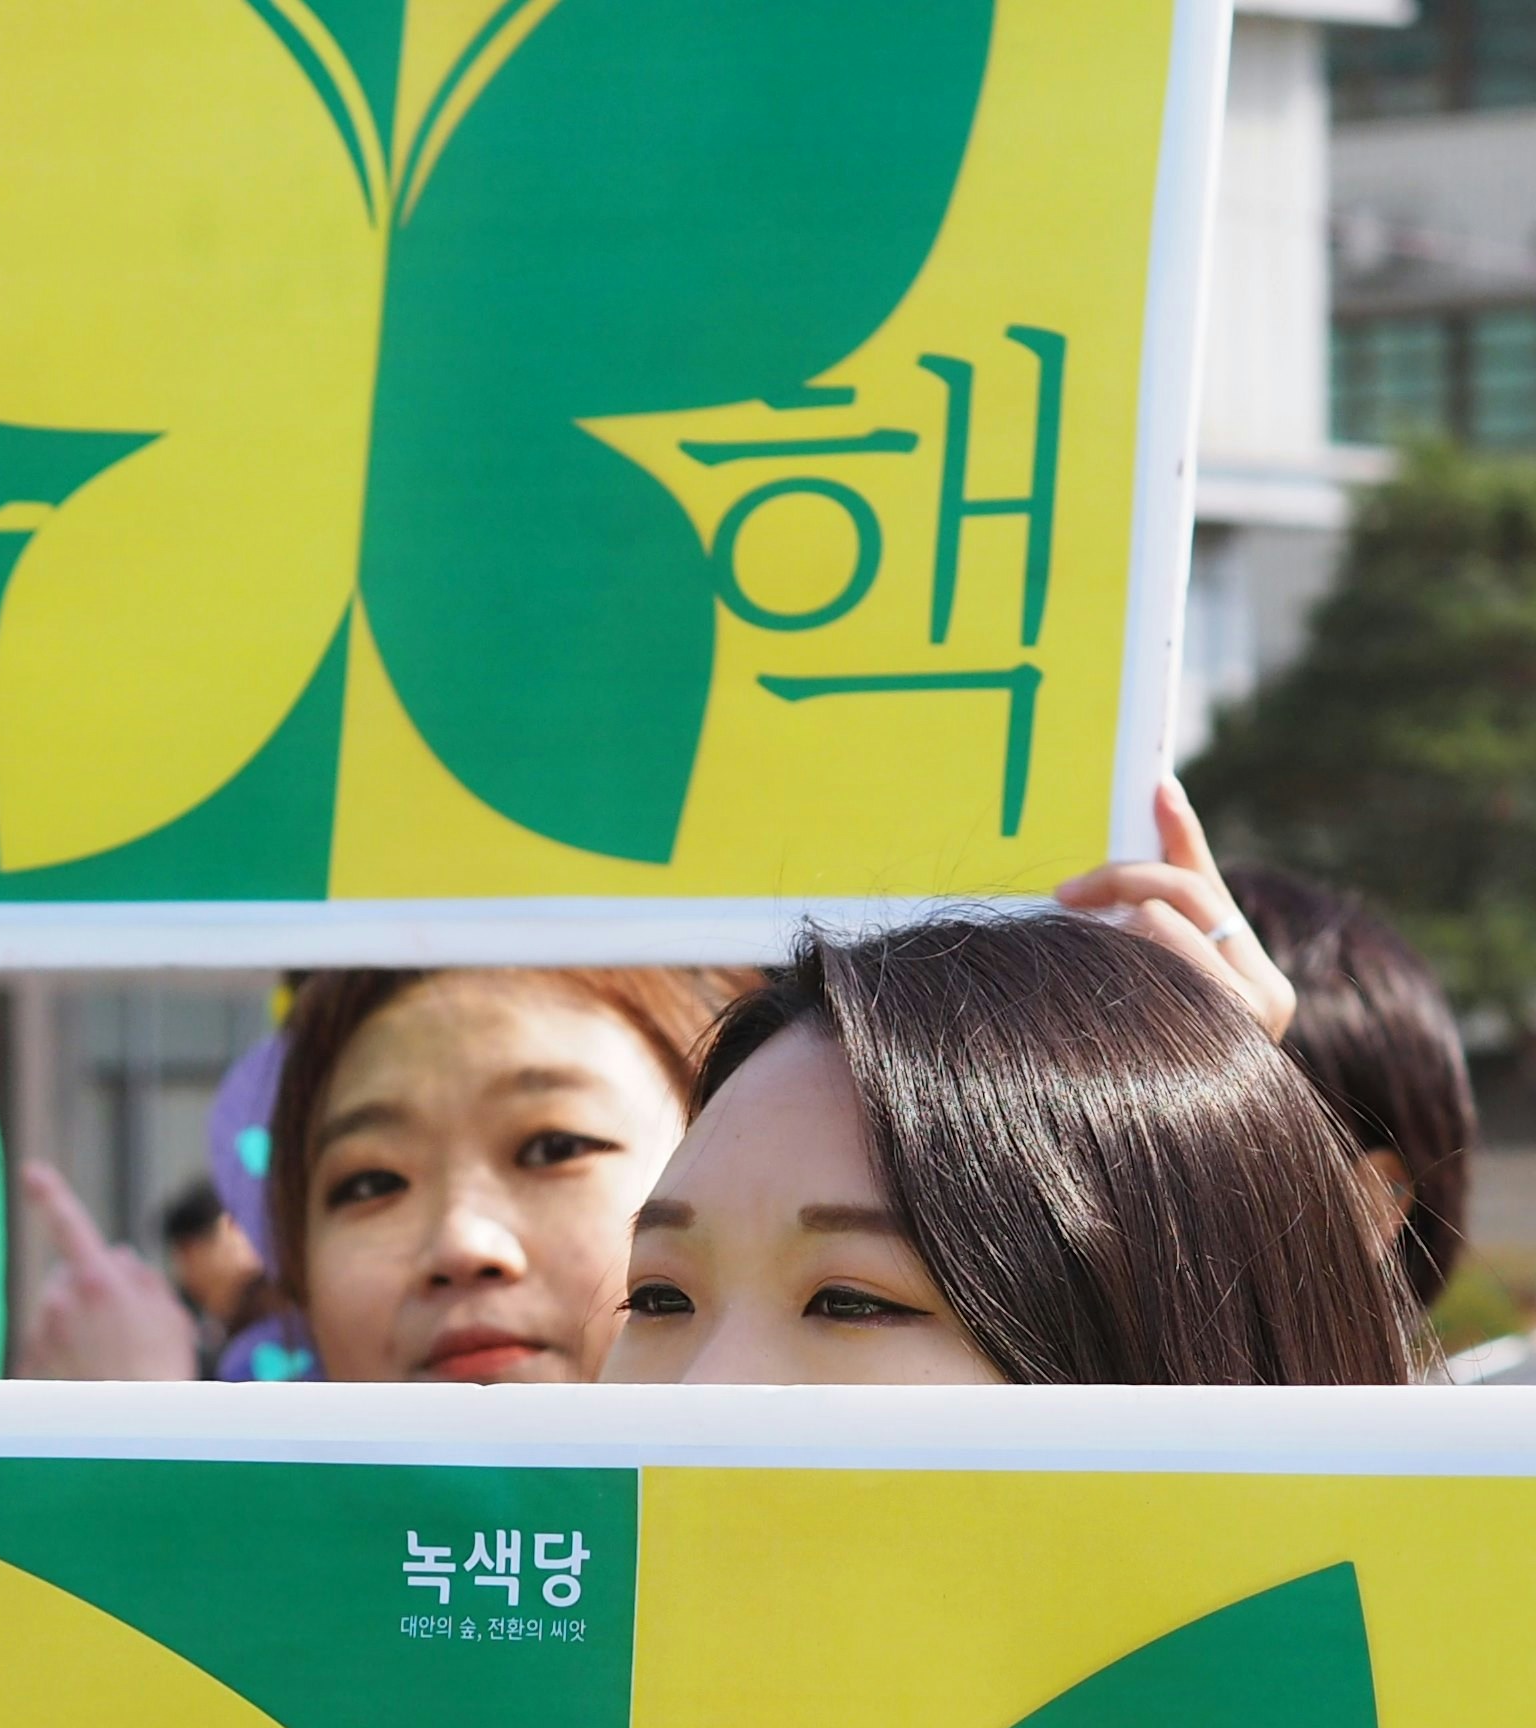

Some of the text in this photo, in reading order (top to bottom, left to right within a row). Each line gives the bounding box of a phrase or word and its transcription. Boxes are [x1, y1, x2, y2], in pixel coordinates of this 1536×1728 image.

[677, 323, 1068, 838] 핵
[402, 1529, 591, 1608] 녹색당
[400, 1615, 587, 1642] 대안의 숲, 전환의 씨앗
